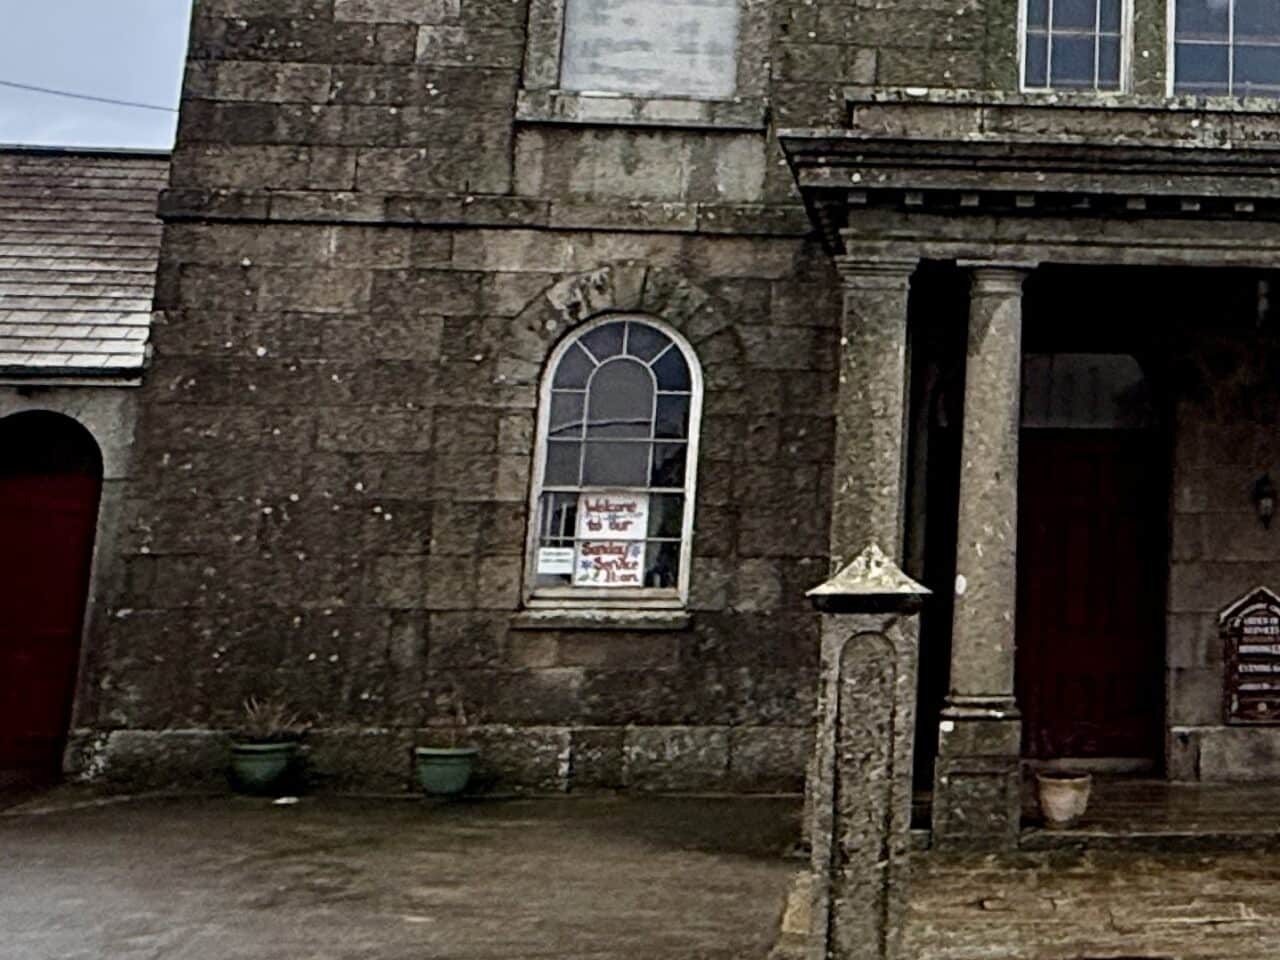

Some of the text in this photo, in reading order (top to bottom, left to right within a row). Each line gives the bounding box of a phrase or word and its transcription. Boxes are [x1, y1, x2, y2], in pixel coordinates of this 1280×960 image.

[584, 499, 637, 513] Welcome
[586, 519, 603, 531] to
[581, 541, 629, 559] Sunday
[594, 556, 640, 571] Service
